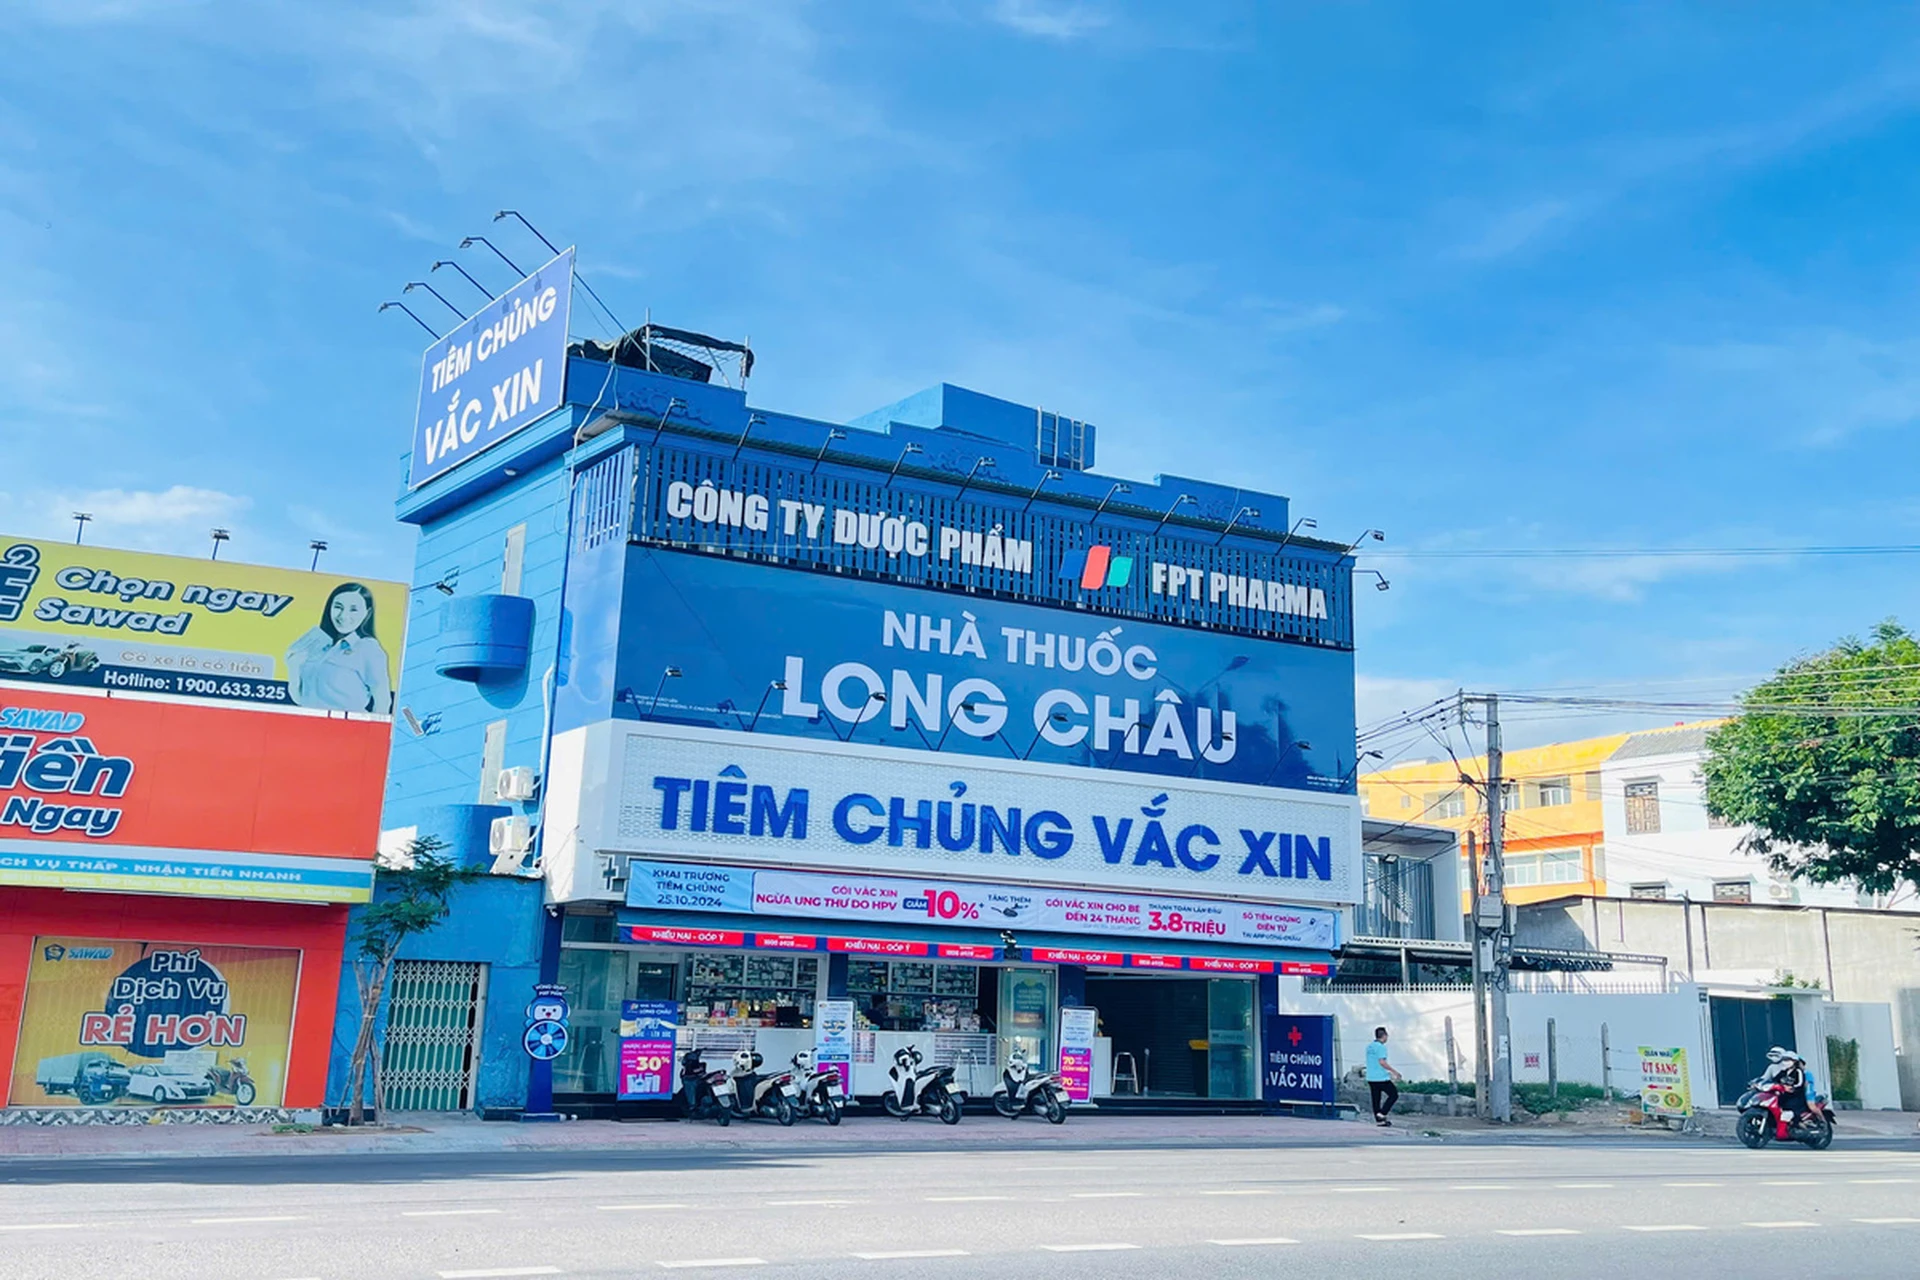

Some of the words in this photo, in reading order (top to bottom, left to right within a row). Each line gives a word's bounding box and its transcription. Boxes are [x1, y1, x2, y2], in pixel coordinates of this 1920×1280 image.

[432, 341, 472, 393] TIÊM
[477, 286, 557, 361] CHỦNG
[425, 389, 482, 465] VẮC
[487, 358, 543, 431] XIN
[667, 479, 769, 531] CÔNG
[780, 499, 825, 539] TY
[834, 509, 928, 558] DƯỢC
[940, 523, 1032, 574] PHẨM
[56, 567, 174, 602] Chọn
[182, 585, 293, 616] ngay
[1152, 562, 1204, 600] FPT
[1210, 572, 1328, 620] PHARMA
[34, 597, 191, 635] Sawad
[882, 610, 988, 660] NHÀ
[1001, 625, 1158, 681] THUỐC
[120, 651, 147, 662] Có
[153, 656, 174, 665] xe
[180, 656, 196, 668] là
[202, 658, 224, 671] có
[103, 670, 170, 690] Hotline:
[176, 677, 286, 700] 1900.633.325
[0, 707, 85, 733] SAWAD
[782, 655, 1008, 737] LONG
[1032, 688, 1237, 764] CHÂU
[0, 796, 122, 837] Ngay
[653, 764, 810, 839] TIÊM
[832, 781, 1074, 859] CHỦNG
[1092, 793, 1221, 872] VẮC
[1237, 829, 1331, 881] XIN
[34, 858, 60, 869] VỤ
[67, 859, 118, 871] THẤP
[134, 863, 186, 876] NHẬN
[239, 869, 302, 881] NHANH
[653, 869, 680, 878] KHAI
[683, 871, 730, 882] TRƯƠNG
[656, 880, 683, 891] TIÊM
[686, 881, 726, 893] CHỦNG
[832, 885, 851, 895] GÓI
[879, 889, 898, 897] XIN
[657, 894, 722, 907] 25.10.2024
[756, 892, 792, 904] NGỪA
[795, 896, 821, 907] UNG
[824, 897, 850, 908] THƯ
[851, 899, 869, 910] DO
[872, 900, 897, 911] HPV
[1045, 898, 1063, 907] GÓI
[1087, 901, 1103, 910] XIN
[1105, 902, 1127, 912] CHO
[1090, 913, 1103, 923] 24
[1105, 913, 1141, 925] THÁNG
[1183, 919, 1226, 937] TRIỆU
[67, 947, 114, 960] SAWAD
[151, 949, 201, 972] Phí
[113, 977, 181, 1004] Dịch
[187, 978, 227, 1004] Vụ
[81, 1004, 135, 1044] RẺ
[145, 1011, 246, 1046] HƠN
[636, 1056, 670, 1071] 30%
[1270, 1065, 1297, 1087] VẮC
[1300, 1073, 1323, 1090] XIN
